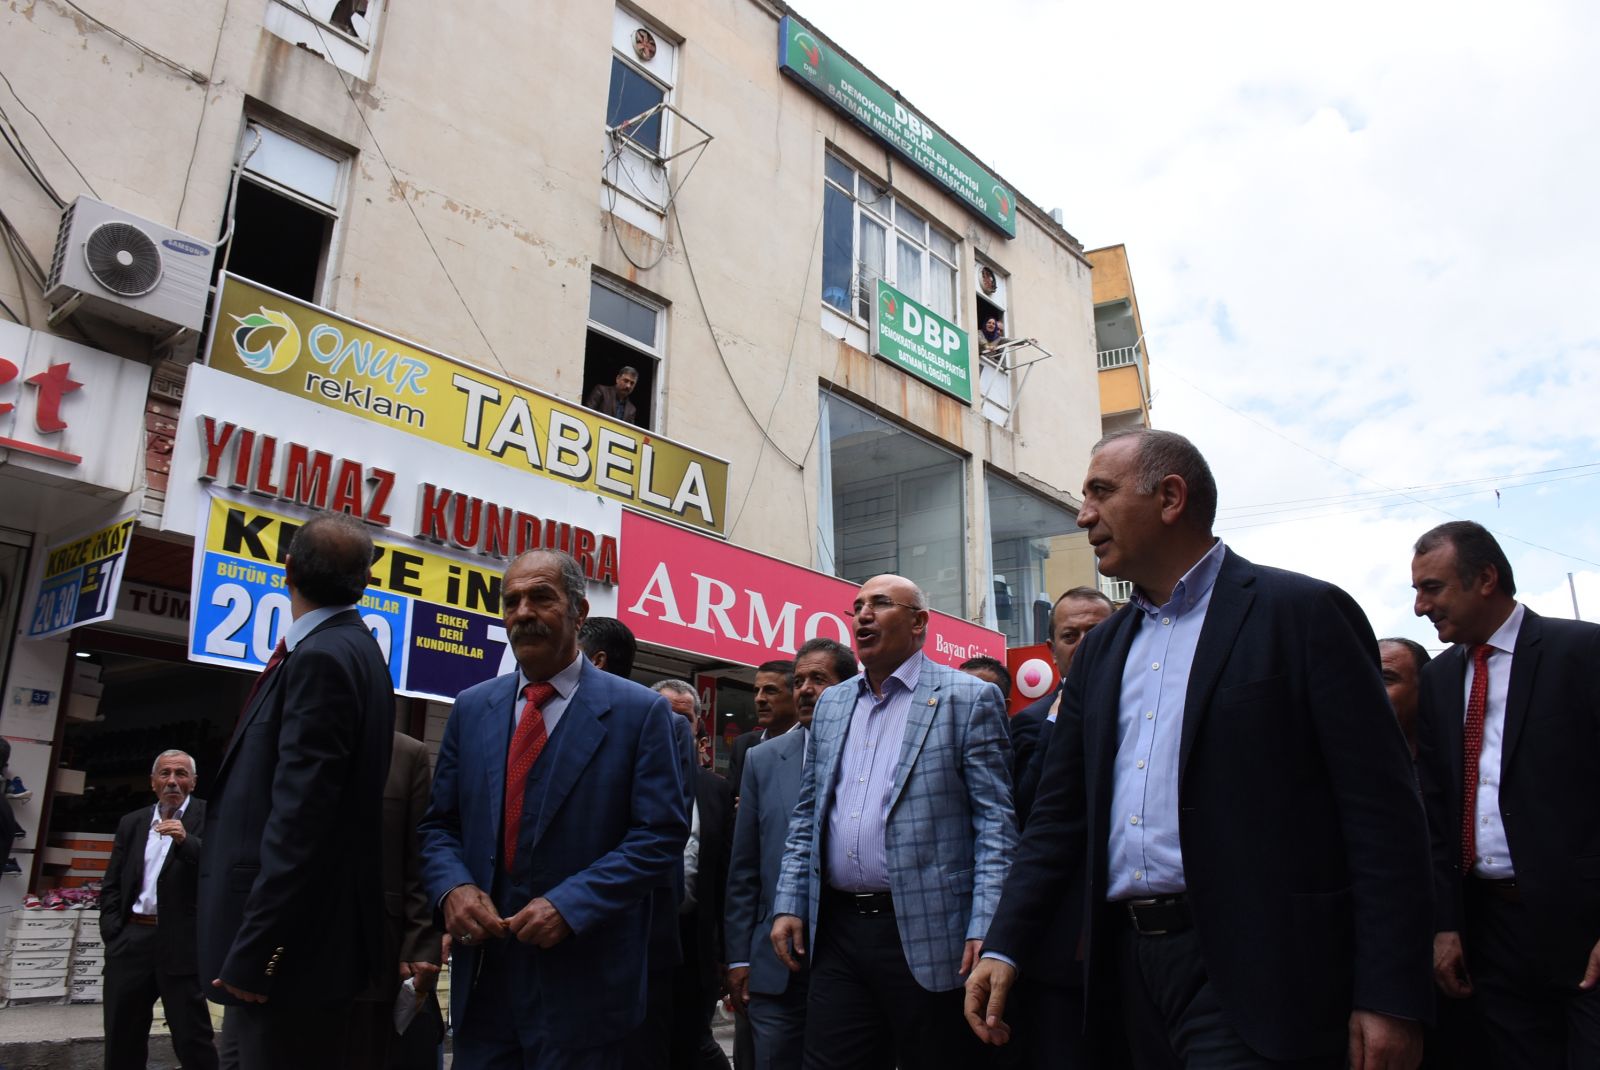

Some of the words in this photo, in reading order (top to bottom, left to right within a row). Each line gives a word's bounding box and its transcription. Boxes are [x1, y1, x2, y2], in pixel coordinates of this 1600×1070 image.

[828, 84, 871, 122] BATMAN
[873, 117, 913, 155] MERKEZ
[914, 147, 935, 171] İLÇE
[841, 79, 902, 132] DEMOKRATİK
[903, 128, 948, 169] BÖLGELER
[949, 163, 979, 192] PARTİSİ
[894, 102, 933, 142] DBP
[903, 302, 961, 355] DBP
[304, 371, 427, 428] reklam
[308, 323, 431, 396] ONUR
[452, 373, 715, 526] TABELA
[197, 414, 395, 527] YILMAZ
[415, 482, 619, 586] KUNDURA
[217, 561, 267, 585] BÜTÜN
[436, 612, 469, 630] ERKEK
[628, 562, 851, 655] ARMO
[416, 635, 484, 660] KUNDURALAR
[440, 627, 463, 642] DERİ
[936, 633, 966, 661] Bayan
[33, 692, 48, 702] 37
